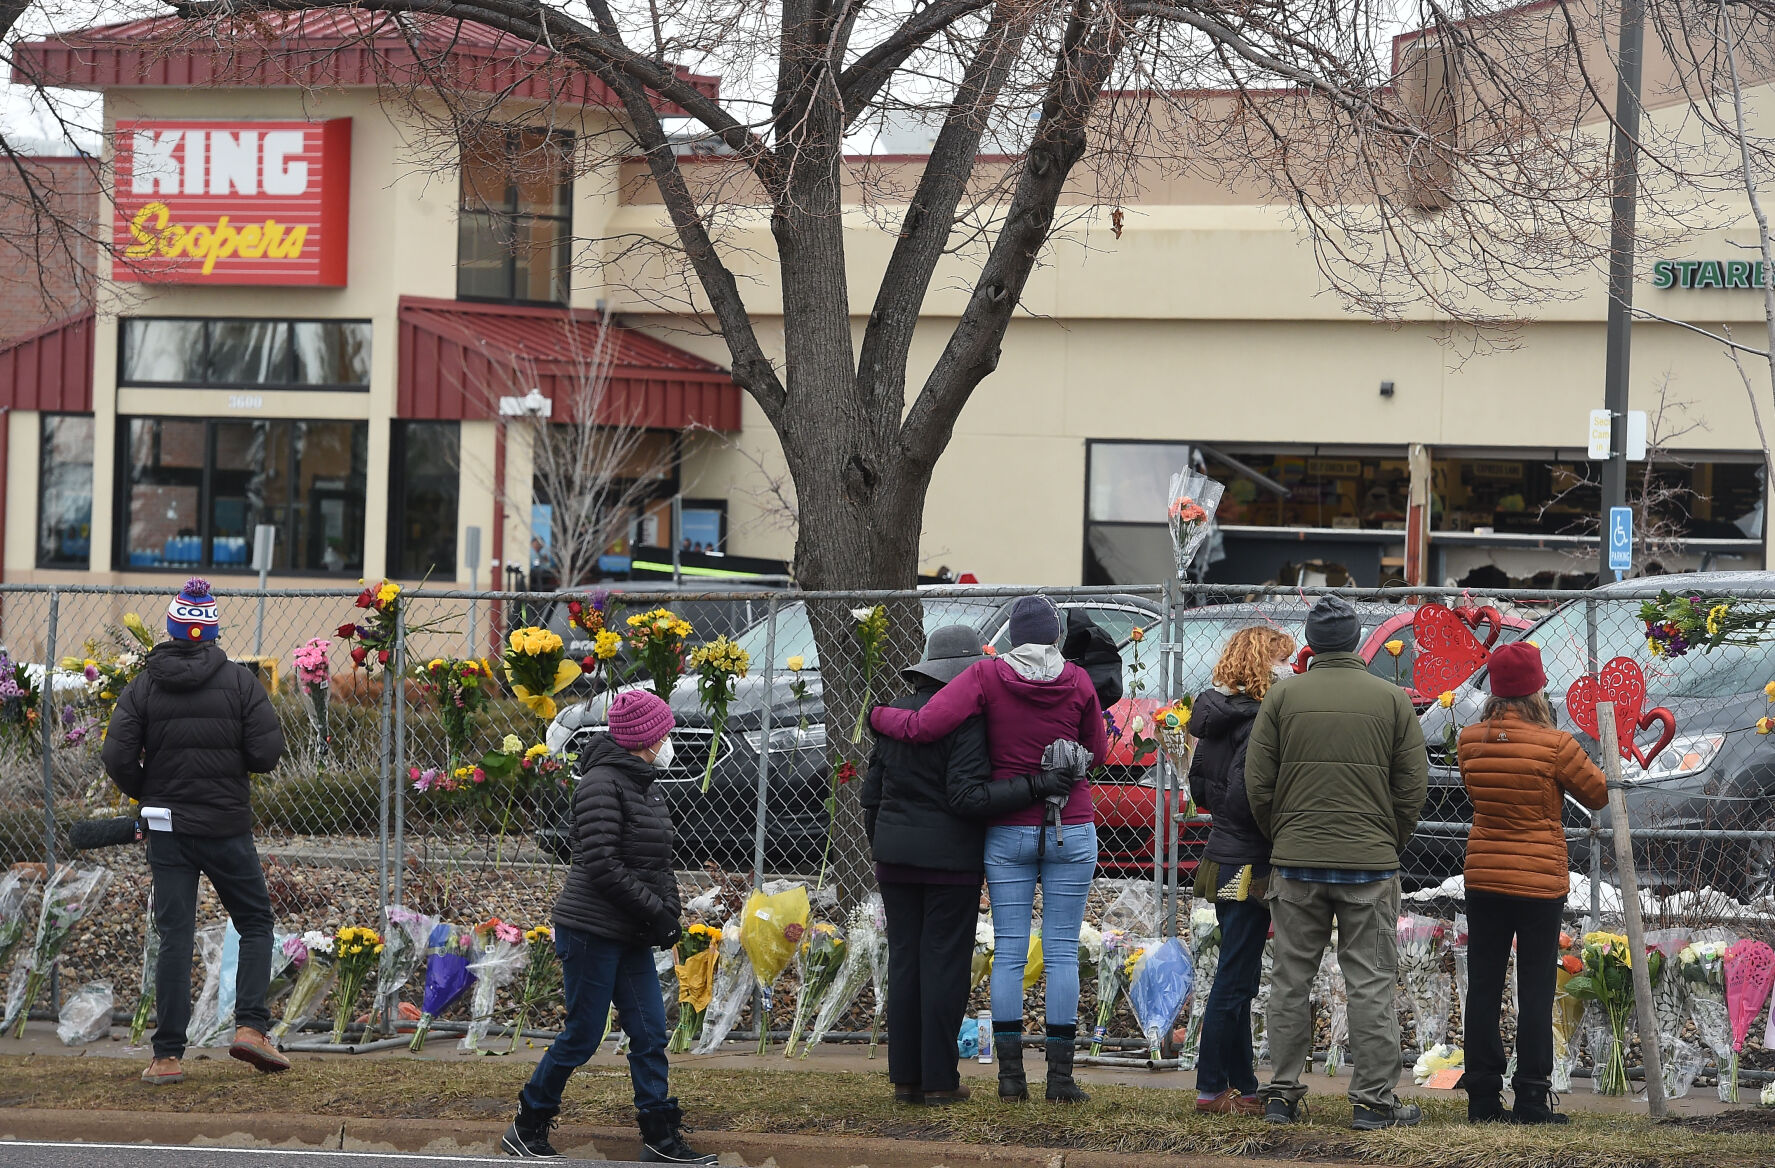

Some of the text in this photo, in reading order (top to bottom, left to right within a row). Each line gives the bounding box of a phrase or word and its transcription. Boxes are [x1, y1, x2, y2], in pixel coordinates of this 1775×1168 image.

[132, 130, 308, 195] KING
[125, 202, 309, 275] Soopers
[228, 395, 263, 408] 3600
[1611, 551, 1630, 562] PARKING
